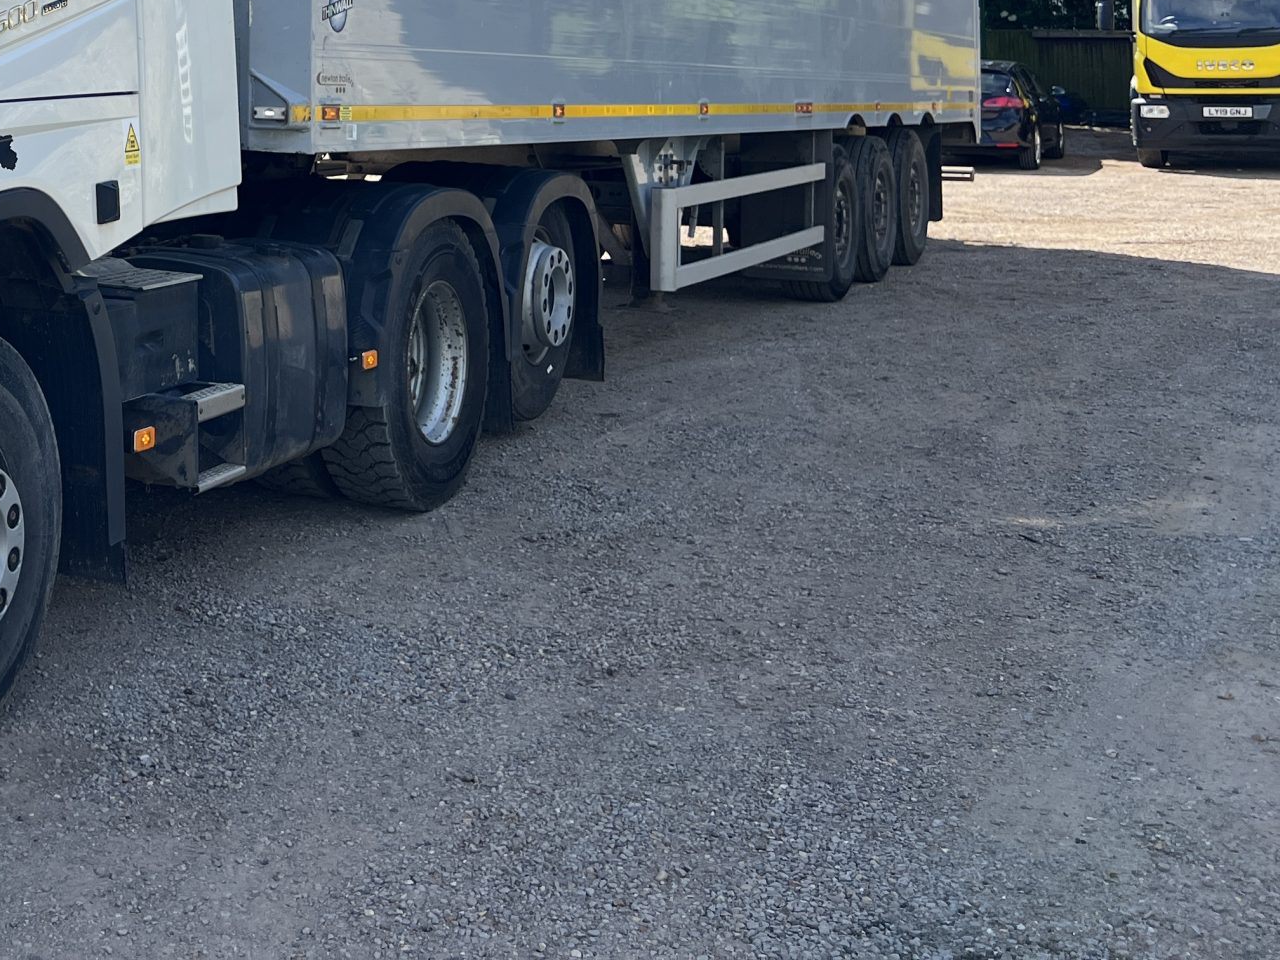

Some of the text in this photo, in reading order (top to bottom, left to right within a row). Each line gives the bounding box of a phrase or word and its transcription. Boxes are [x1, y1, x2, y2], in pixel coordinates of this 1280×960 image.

[1196, 59, 1255, 71] IVECO
[1208, 108, 1247, 116] LY19 GNJ
